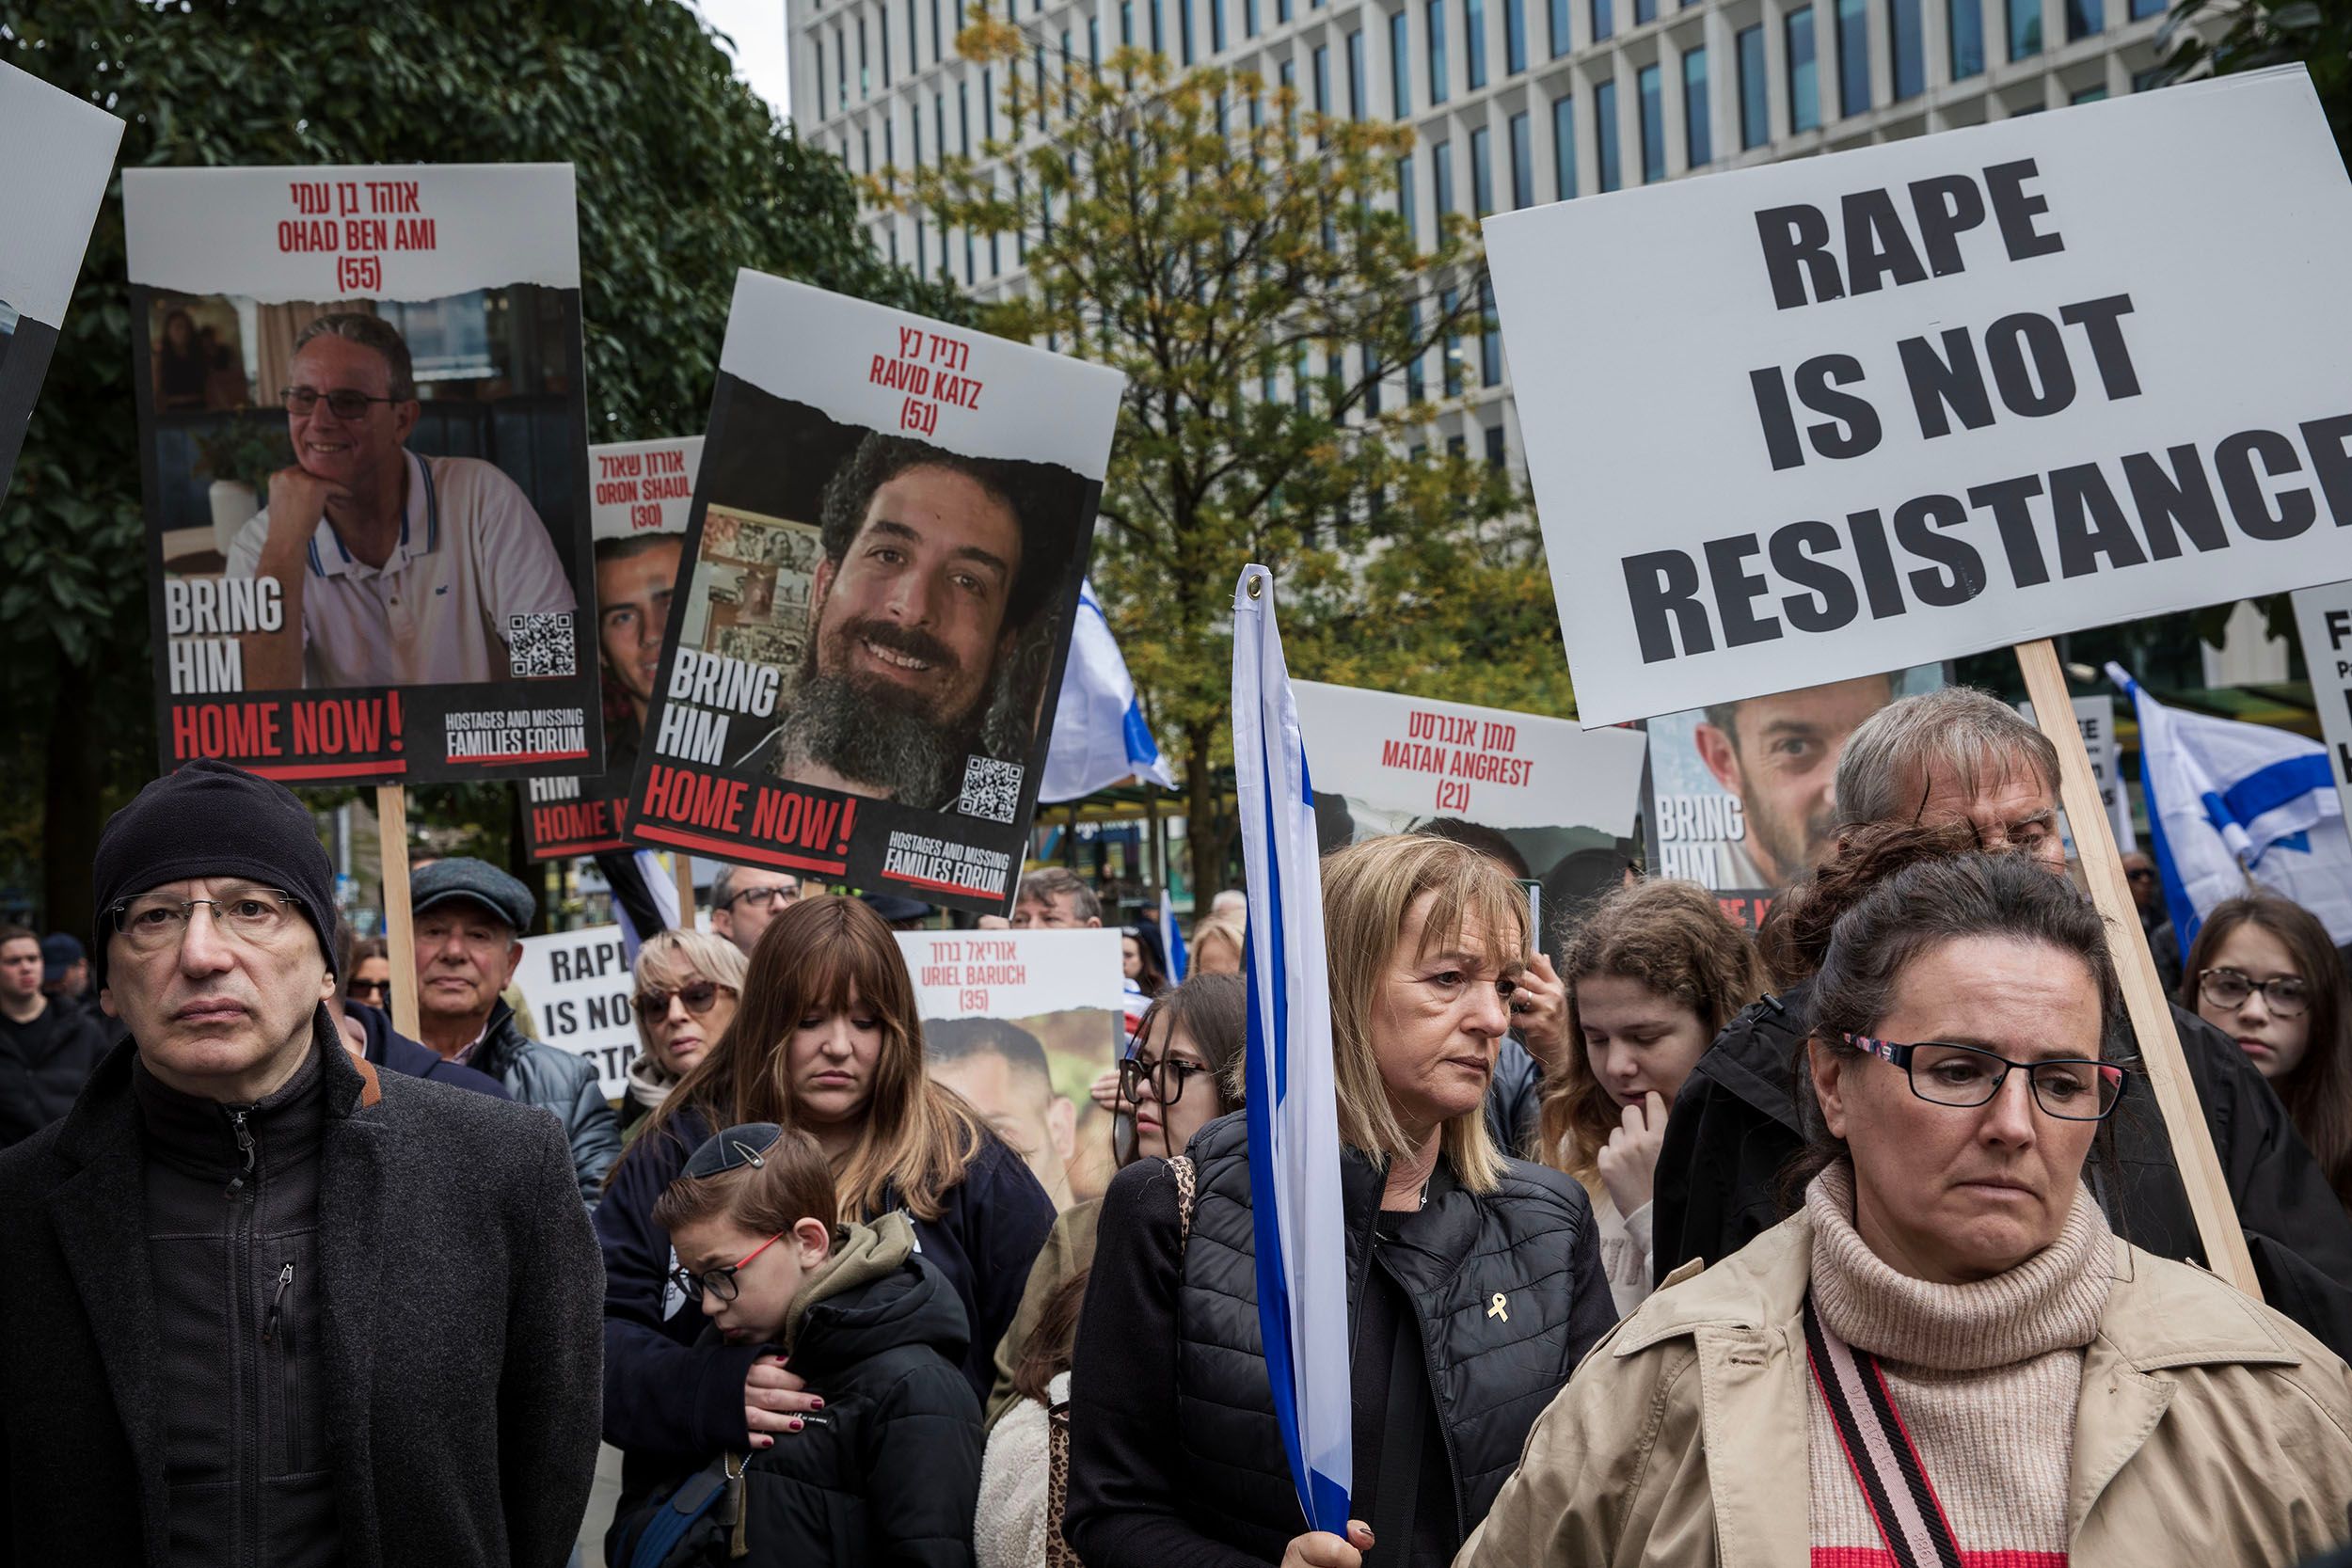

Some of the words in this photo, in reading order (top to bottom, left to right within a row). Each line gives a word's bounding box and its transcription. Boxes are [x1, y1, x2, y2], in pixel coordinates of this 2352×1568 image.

[289, 182, 330, 214] עמי
[336, 182, 360, 217] בן
[364, 181, 421, 214] אוהד
[278, 220, 339, 252] OHAD
[345, 219, 388, 251] BEN
[394, 218, 437, 250] AMI
[1754, 156, 2066, 311] RAPE
[337, 255, 382, 293] (55)
[899, 326, 923, 358] כץ
[929, 334, 970, 372] רביד
[869, 354, 930, 395] RAVID
[932, 372, 983, 411] KATZ
[1748, 354, 1883, 472] IS
[1897, 293, 2143, 441] NOT
[900, 396, 938, 436] (51)
[597, 453, 642, 479] שאול
[644, 450, 685, 477] אורון
[596, 481, 638, 506] ORON
[642, 476, 692, 500] SHAUL
[631, 503, 662, 530] (30)
[165, 576, 283, 635] BRING
[168, 638, 243, 694] HIM
[667, 646, 780, 718] BRING
[172, 702, 282, 759] HOME
[292, 690, 405, 754] NOW!
[445, 711, 505, 731] HOSTAGES
[506, 709, 531, 728] AND
[532, 708, 584, 727] MISSING
[655, 703, 730, 767] HIM
[1408, 711, 1478, 747] אנגרסט
[1482, 722, 1517, 752] מתן
[446, 729, 522, 756] FAMILIES
[525, 727, 586, 754] FORUM
[1382, 739, 1447, 774] MATAN
[1449, 751, 1534, 787] ANGREST
[529, 776, 580, 803] HIM
[1436, 779, 1470, 814] (21)
[532, 800, 609, 844] HOME
[642, 764, 749, 834] HOME
[751, 786, 857, 856] NOW!
[1655, 794, 1746, 842] BRING
[889, 831, 942, 857] HOSTAGES
[942, 842, 964, 862] AND
[963, 847, 1010, 870] MISSING
[1660, 846, 1720, 890] HIM
[883, 847, 953, 884] FAMILIES
[951, 862, 1008, 895] FORUM
[930, 942, 961, 963] ברוך
[965, 940, 1017, 961] אוריאל
[921, 965, 961, 987] URIEL
[966, 964, 1026, 986] BARUCH
[544, 1001, 578, 1037] IS
[587, 993, 631, 1030] NO
[959, 989, 989, 1012] (35)
[1912, 1532, 1935, 1568] 1988
